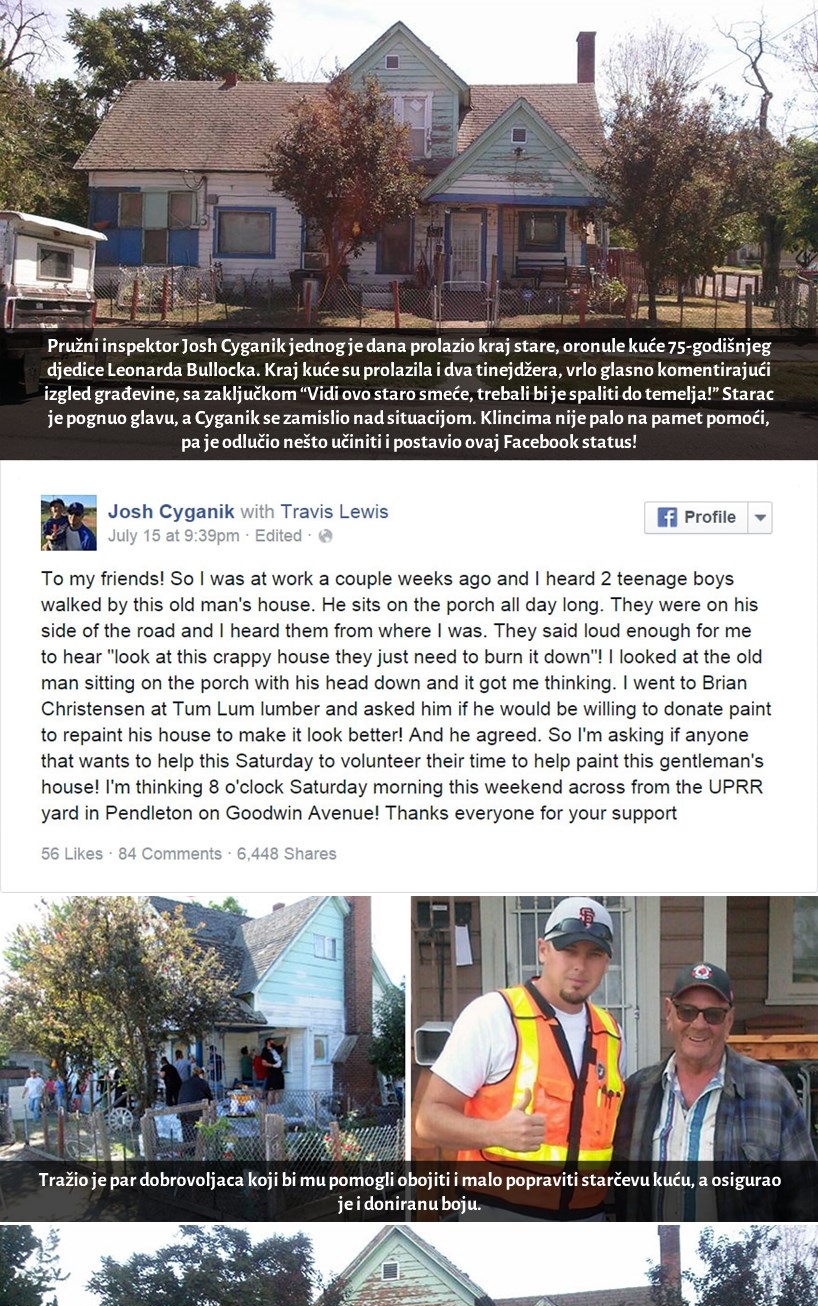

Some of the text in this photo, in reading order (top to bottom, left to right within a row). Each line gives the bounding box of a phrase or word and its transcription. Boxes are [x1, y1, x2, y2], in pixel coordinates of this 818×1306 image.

[107, 503, 389, 523] Josh Cyganik with Travis Lewis
[684, 509, 737, 524] Profile
[107, 528, 303, 546] July 15 at 9:39pm Edited
[40, 570, 735, 590] To my friends! So I was at work a couple weeks ago and I heard 2 teenage boys
[40, 726, 750, 747] to repaint his house to make it look better! And he agreed. So I'm asking if anyone
[41, 778, 764, 799] house! I'm thinking 8 o'clock Saturday morning this weekend across from the UPRR
[40, 804, 678, 825] yard in Pendleton on Goodwin Avenue! Thanks everyone for your support
[41, 846, 337, 862] 56 Likes 84 Comments 6,448 Shares
